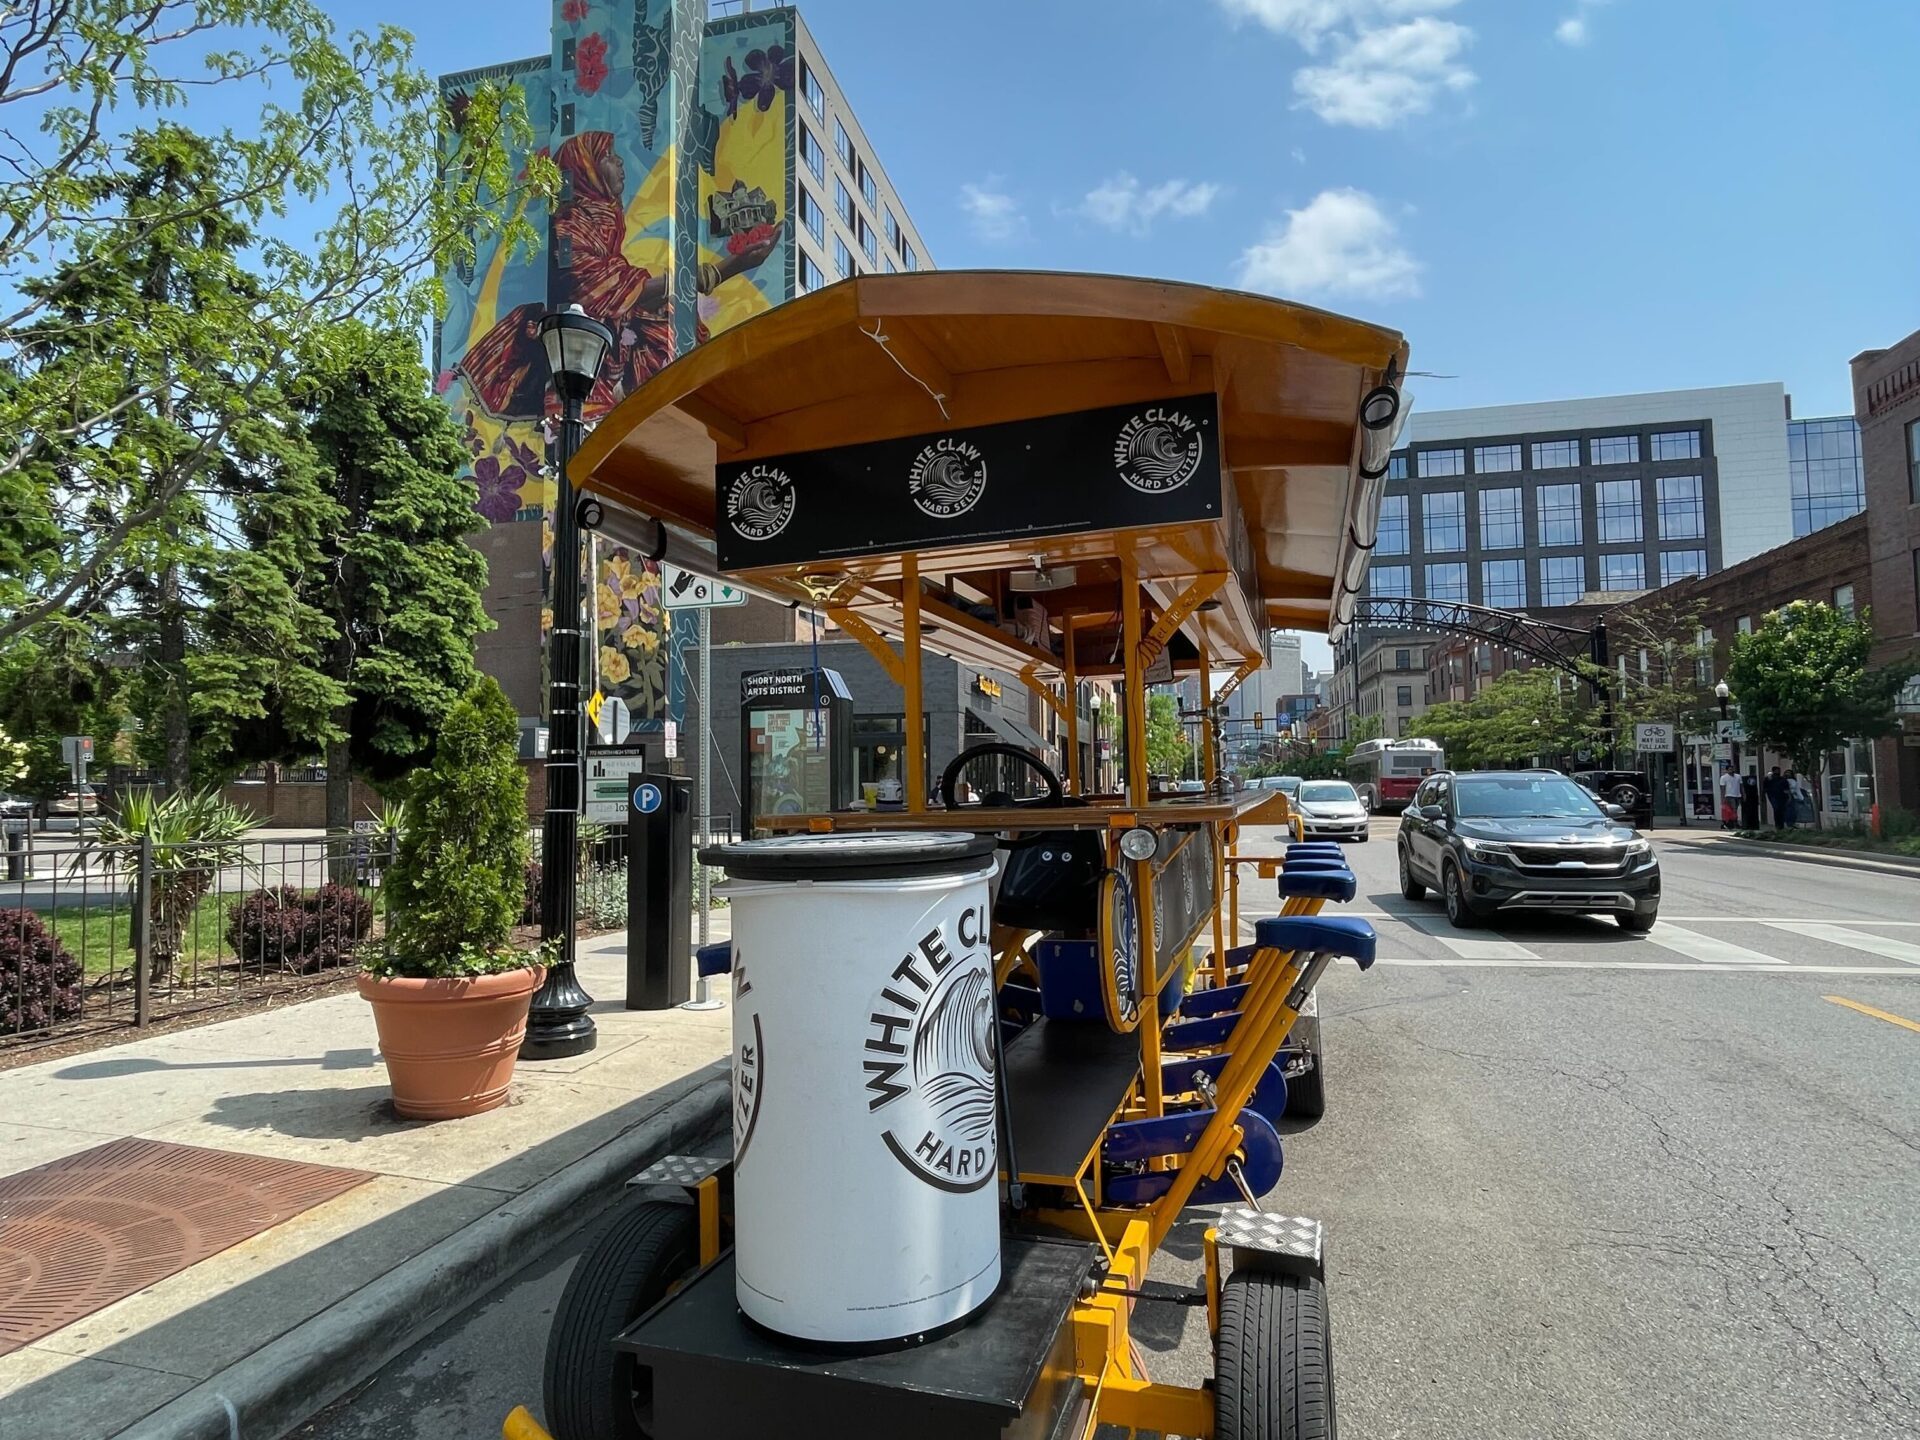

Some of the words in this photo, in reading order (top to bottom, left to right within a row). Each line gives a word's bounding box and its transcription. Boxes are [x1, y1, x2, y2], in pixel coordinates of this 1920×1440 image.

[1114, 415, 1144, 468] WHITE
[1145, 408, 1196, 432] CLAW
[908, 445, 936, 495] WHITE
[936, 438, 981, 461] CLAW
[1130, 472, 1161, 489] HARD
[1165, 442, 1198, 486] SELTZER
[727, 471, 751, 518] WHITE
[751, 465, 791, 487] CLAW
[922, 498, 950, 514] HARD
[954, 470, 982, 511] SELTZER
[738, 521, 763, 536] HARD
[766, 495, 792, 534] SELTZER
[748, 677, 773, 685] SHORT
[775, 675, 803, 684] NORTH
[748, 687, 768, 696] ARTS
[769, 685, 806, 695] DISTRICT
[642, 789, 654, 809] P
[862, 926, 953, 1113] WHITE
[958, 904, 989, 949] CL
[914, 1130, 985, 1176] HARD
